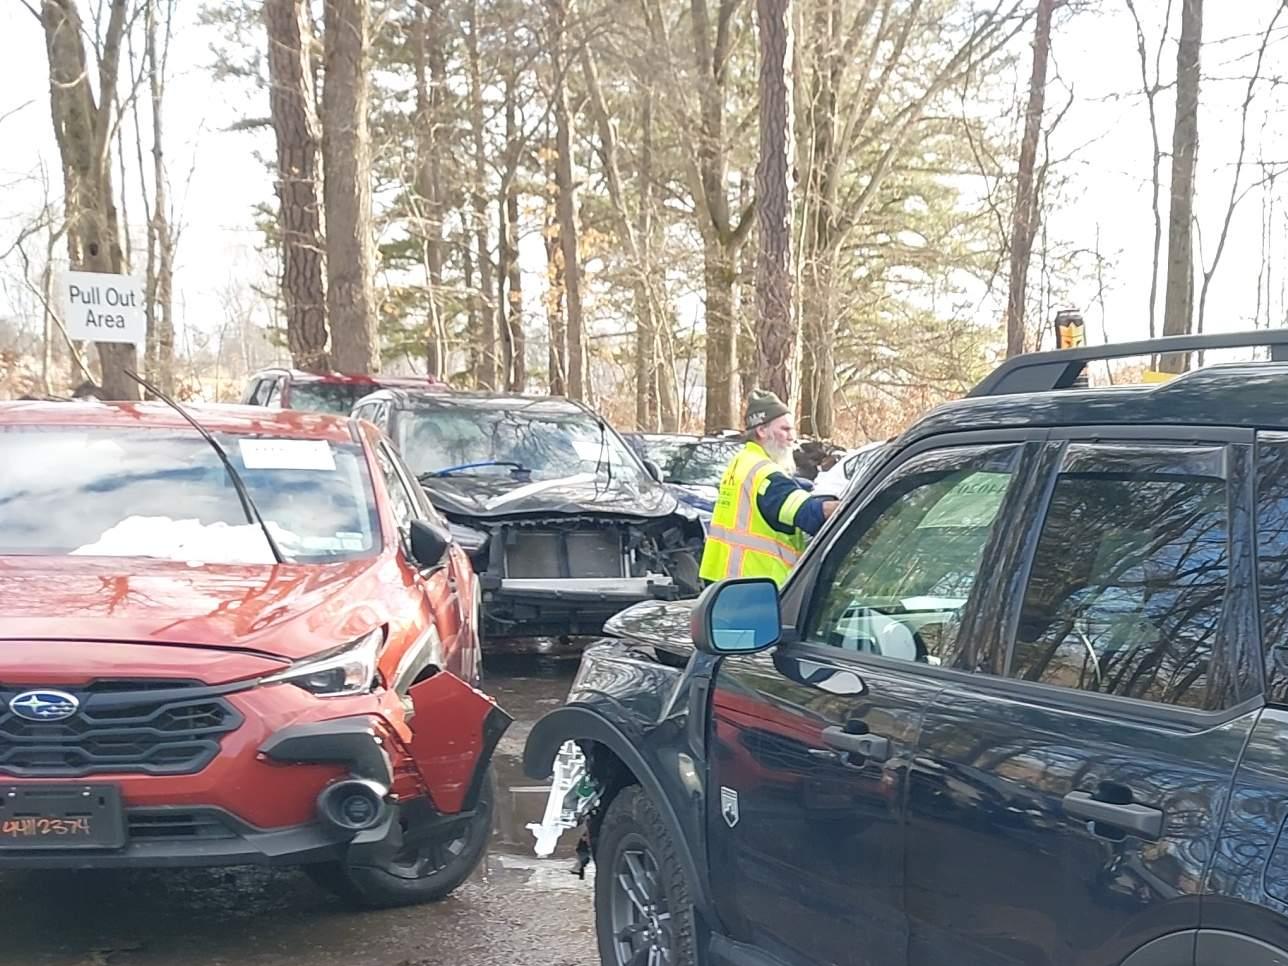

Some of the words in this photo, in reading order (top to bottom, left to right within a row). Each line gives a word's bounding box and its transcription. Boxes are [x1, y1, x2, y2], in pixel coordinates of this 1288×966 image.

[69, 285, 100, 304] Pull
[106, 287, 136, 307] Out
[85, 309, 125, 328] Area
